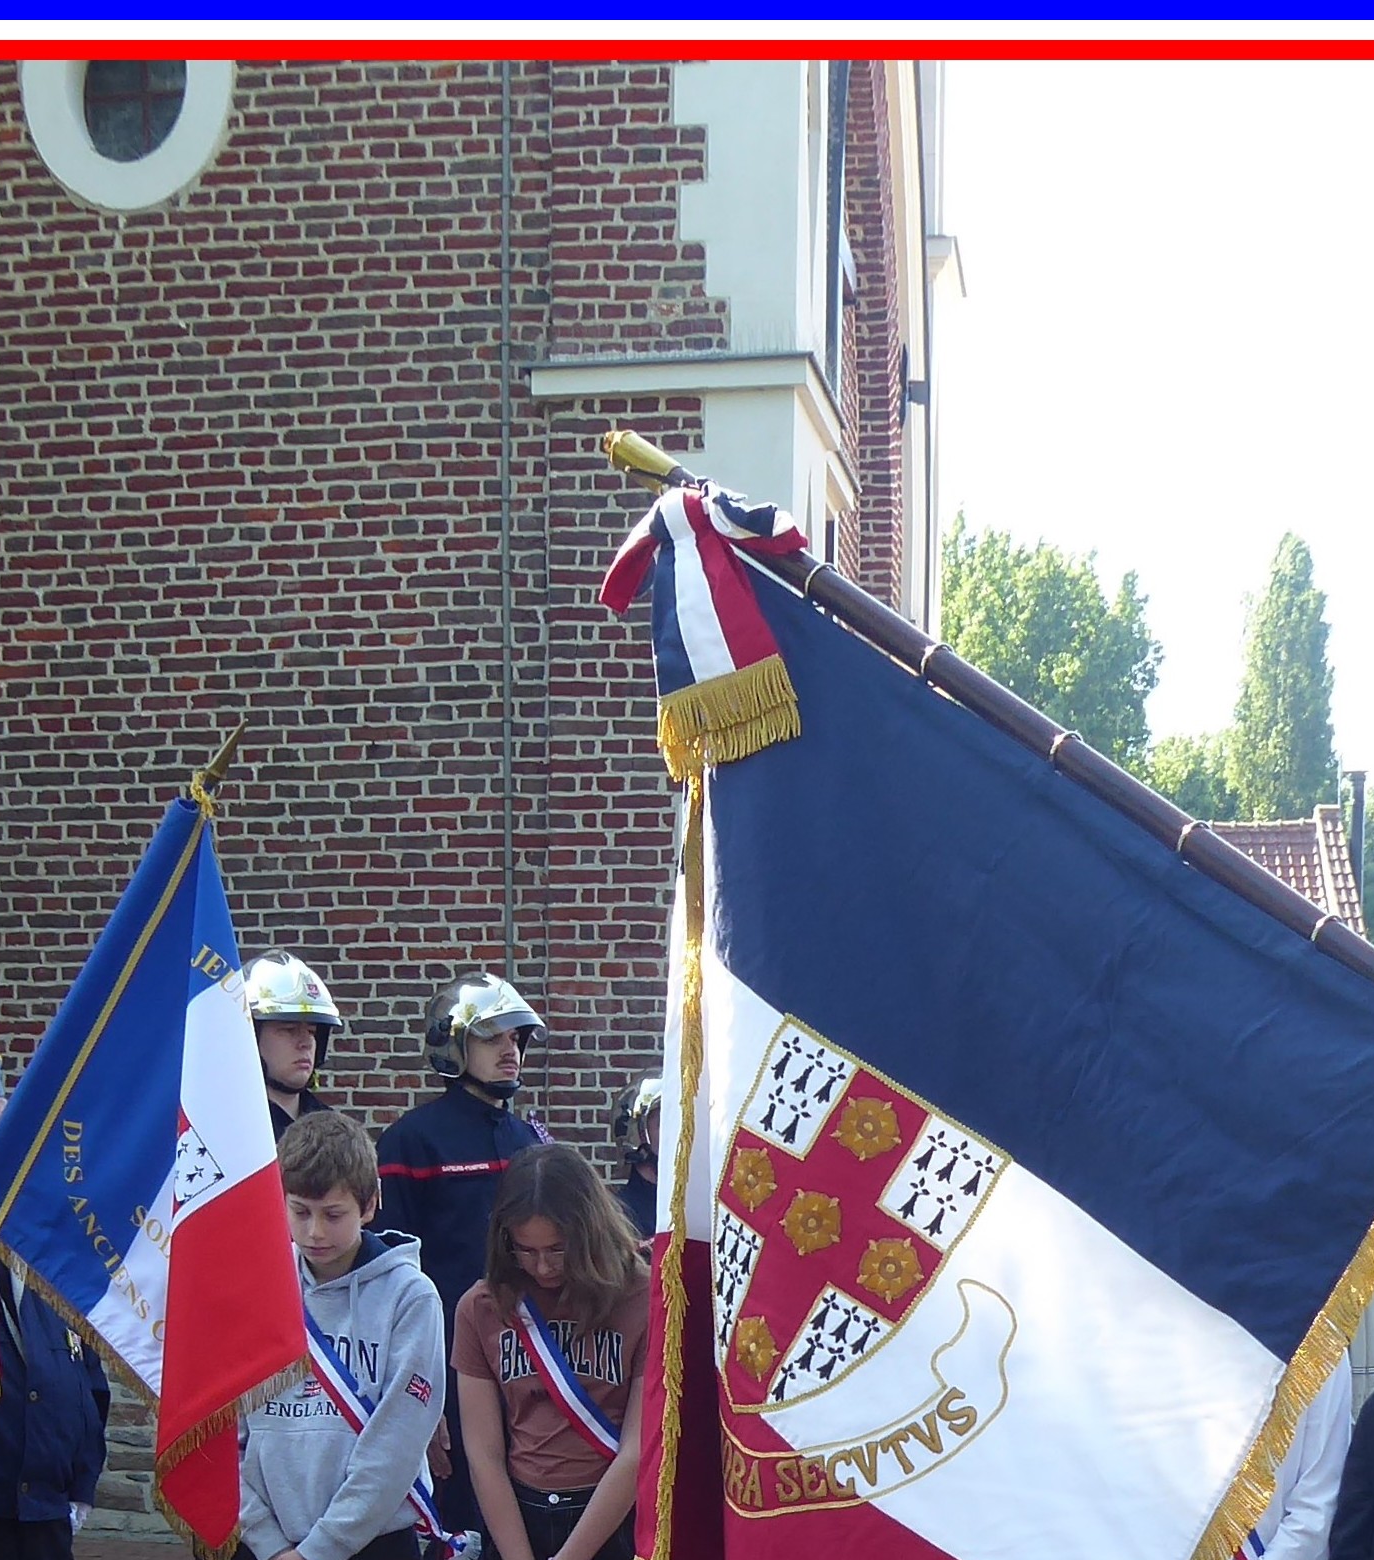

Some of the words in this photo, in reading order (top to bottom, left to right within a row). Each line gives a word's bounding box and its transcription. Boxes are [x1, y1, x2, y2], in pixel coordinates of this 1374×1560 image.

[63, 1120, 83, 1183] DES
[68, 1195, 151, 1320] ANCIENS
[264, 1401, 343, 1418] ENGLAN
[775, 1387, 978, 1503] SECVTVS
